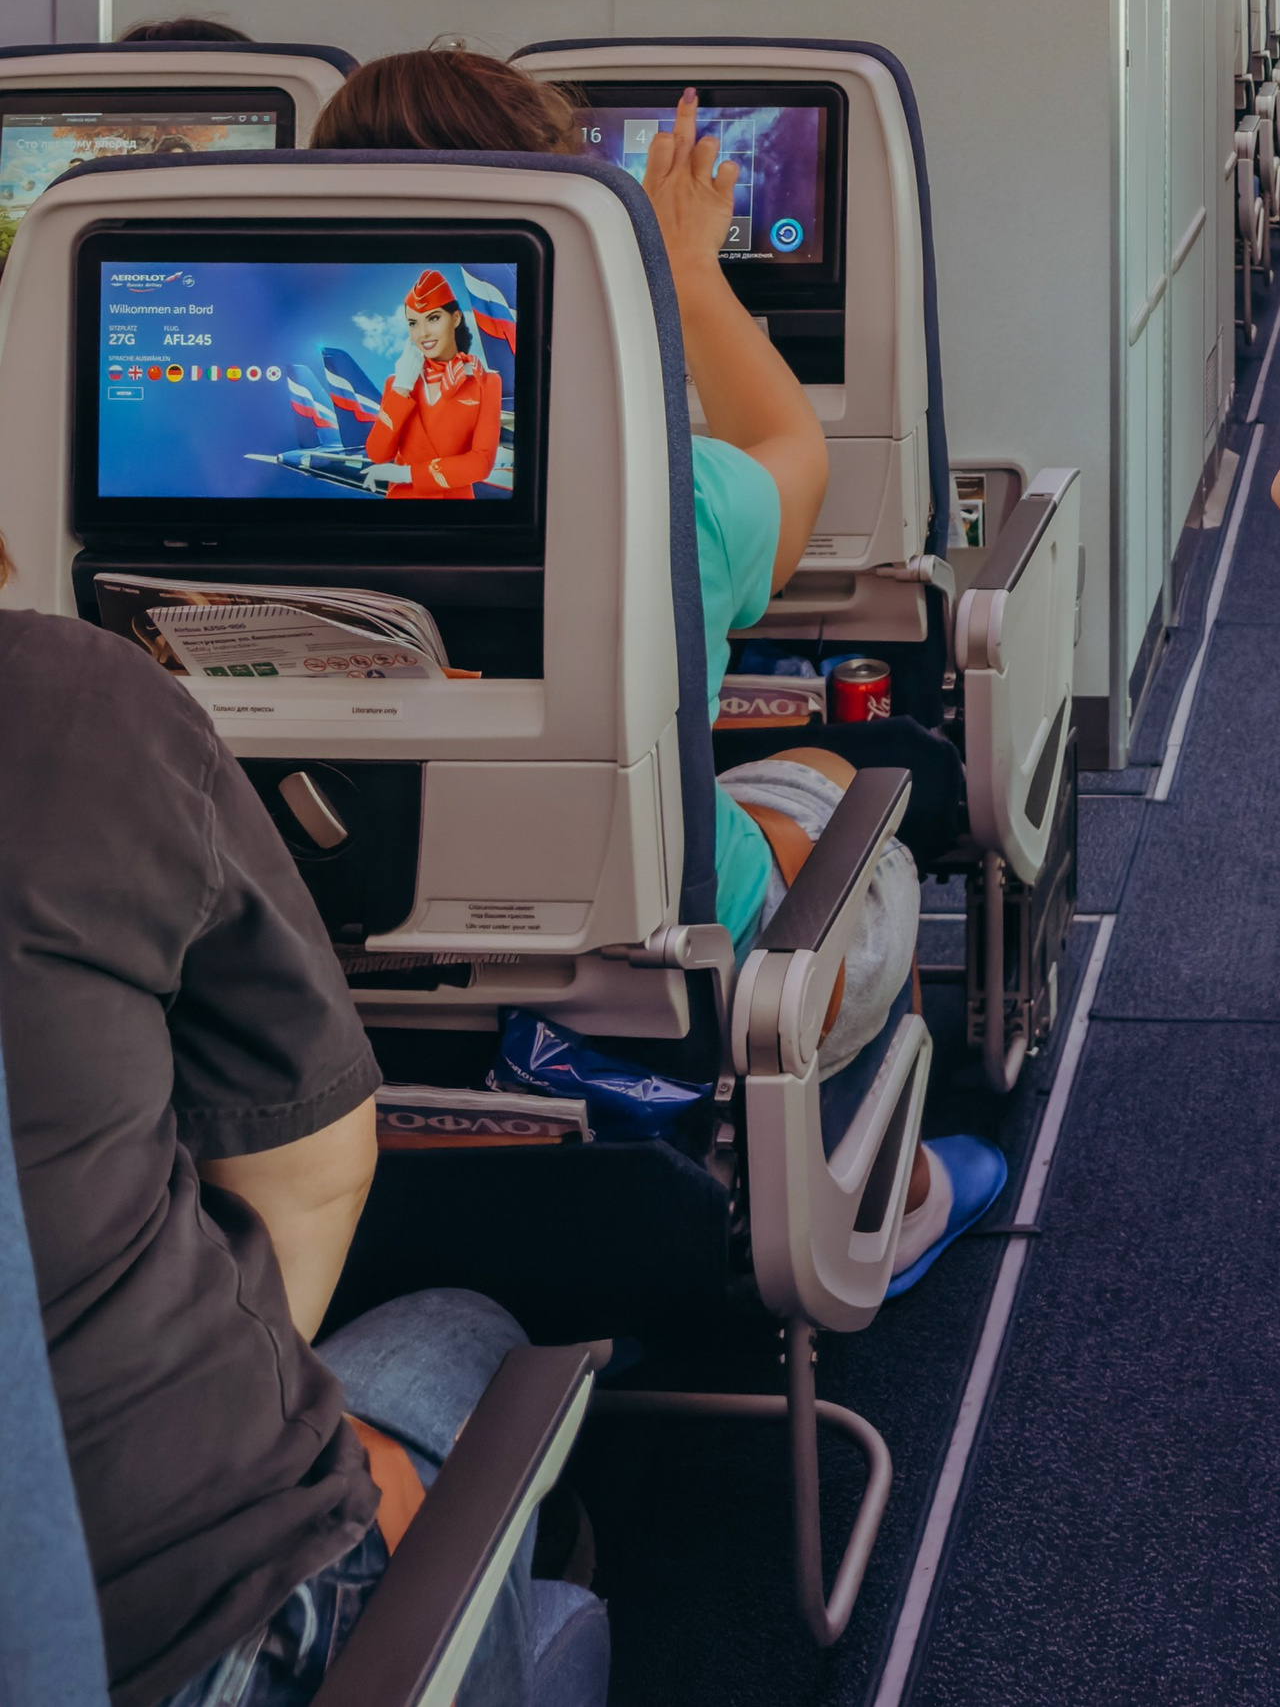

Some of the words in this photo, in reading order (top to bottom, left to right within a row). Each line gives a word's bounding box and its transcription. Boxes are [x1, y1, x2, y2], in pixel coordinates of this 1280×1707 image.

[580, 127, 602, 143] 16
[635, 129, 647, 144] 4
[16, 139, 38, 149] Сто
[728, 225, 741, 242] 2
[110, 274, 167, 282] AEROFLOT
[109, 304, 171, 315] Wilkommen
[173, 306, 186, 315] an
[188, 304, 214, 315] Bord
[108, 333, 136, 346] 27G
[163, 333, 212, 346] AFL245
[212, 704, 236, 712] Только
[383, 708, 398, 716] only
[719, 696, 810, 716] ФЛОТ
